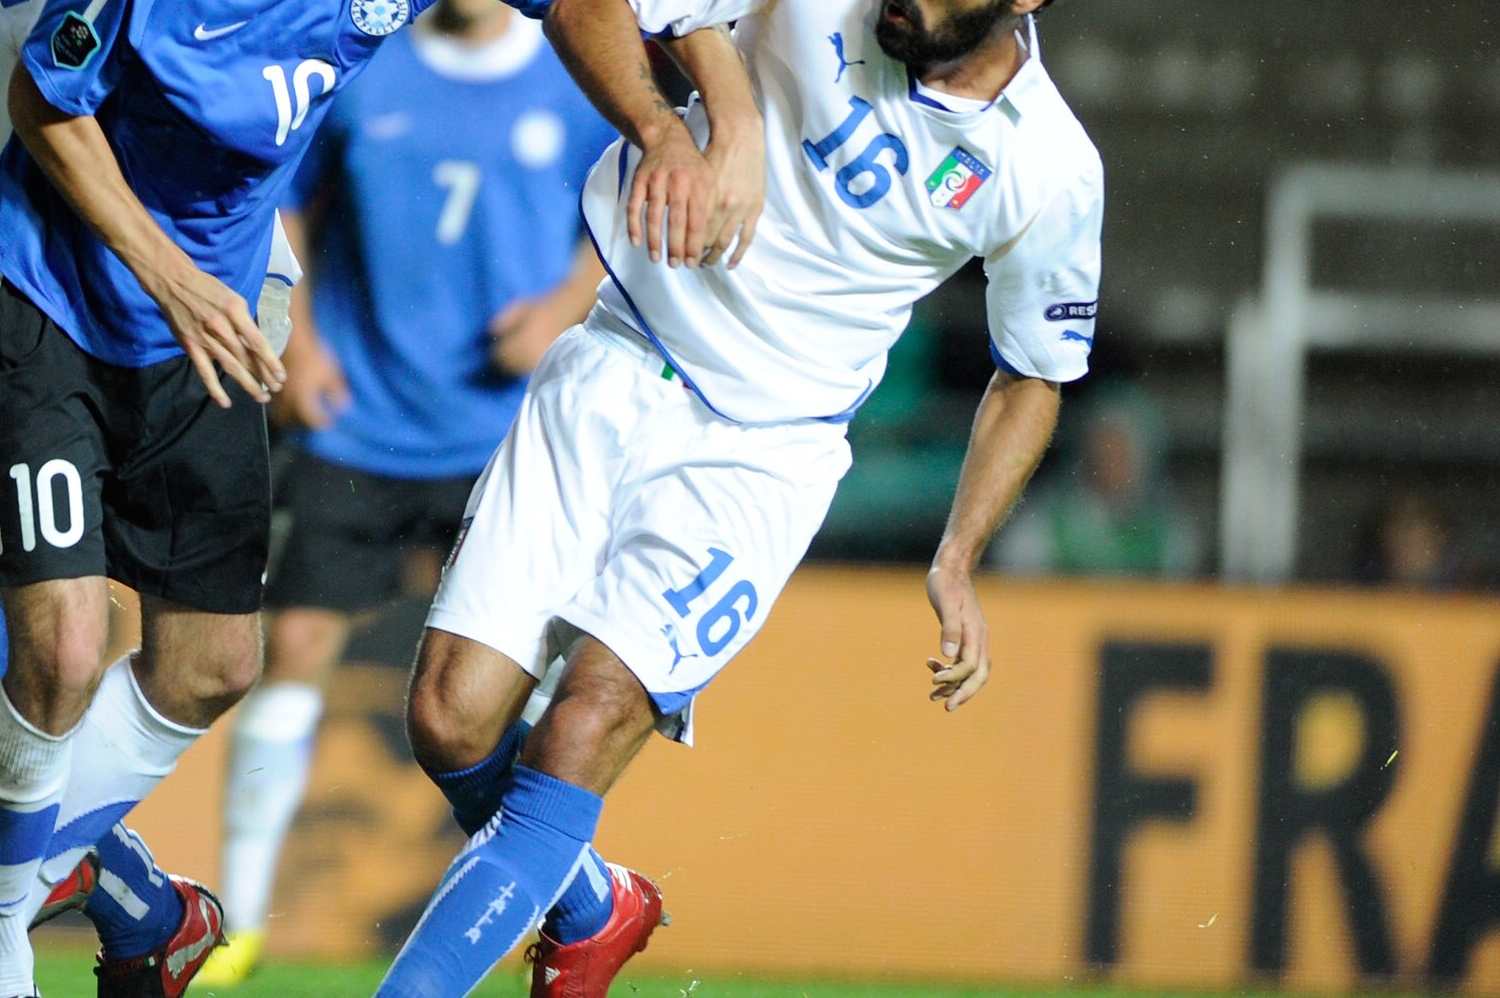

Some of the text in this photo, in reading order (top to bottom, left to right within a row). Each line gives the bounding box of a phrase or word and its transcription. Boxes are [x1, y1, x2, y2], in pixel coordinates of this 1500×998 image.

[801, 95, 909, 209] 16
[432, 158, 482, 247] 7
[1068, 303, 1098, 317] RES
[9, 458, 85, 552] 10
[662, 546, 758, 658] 16
